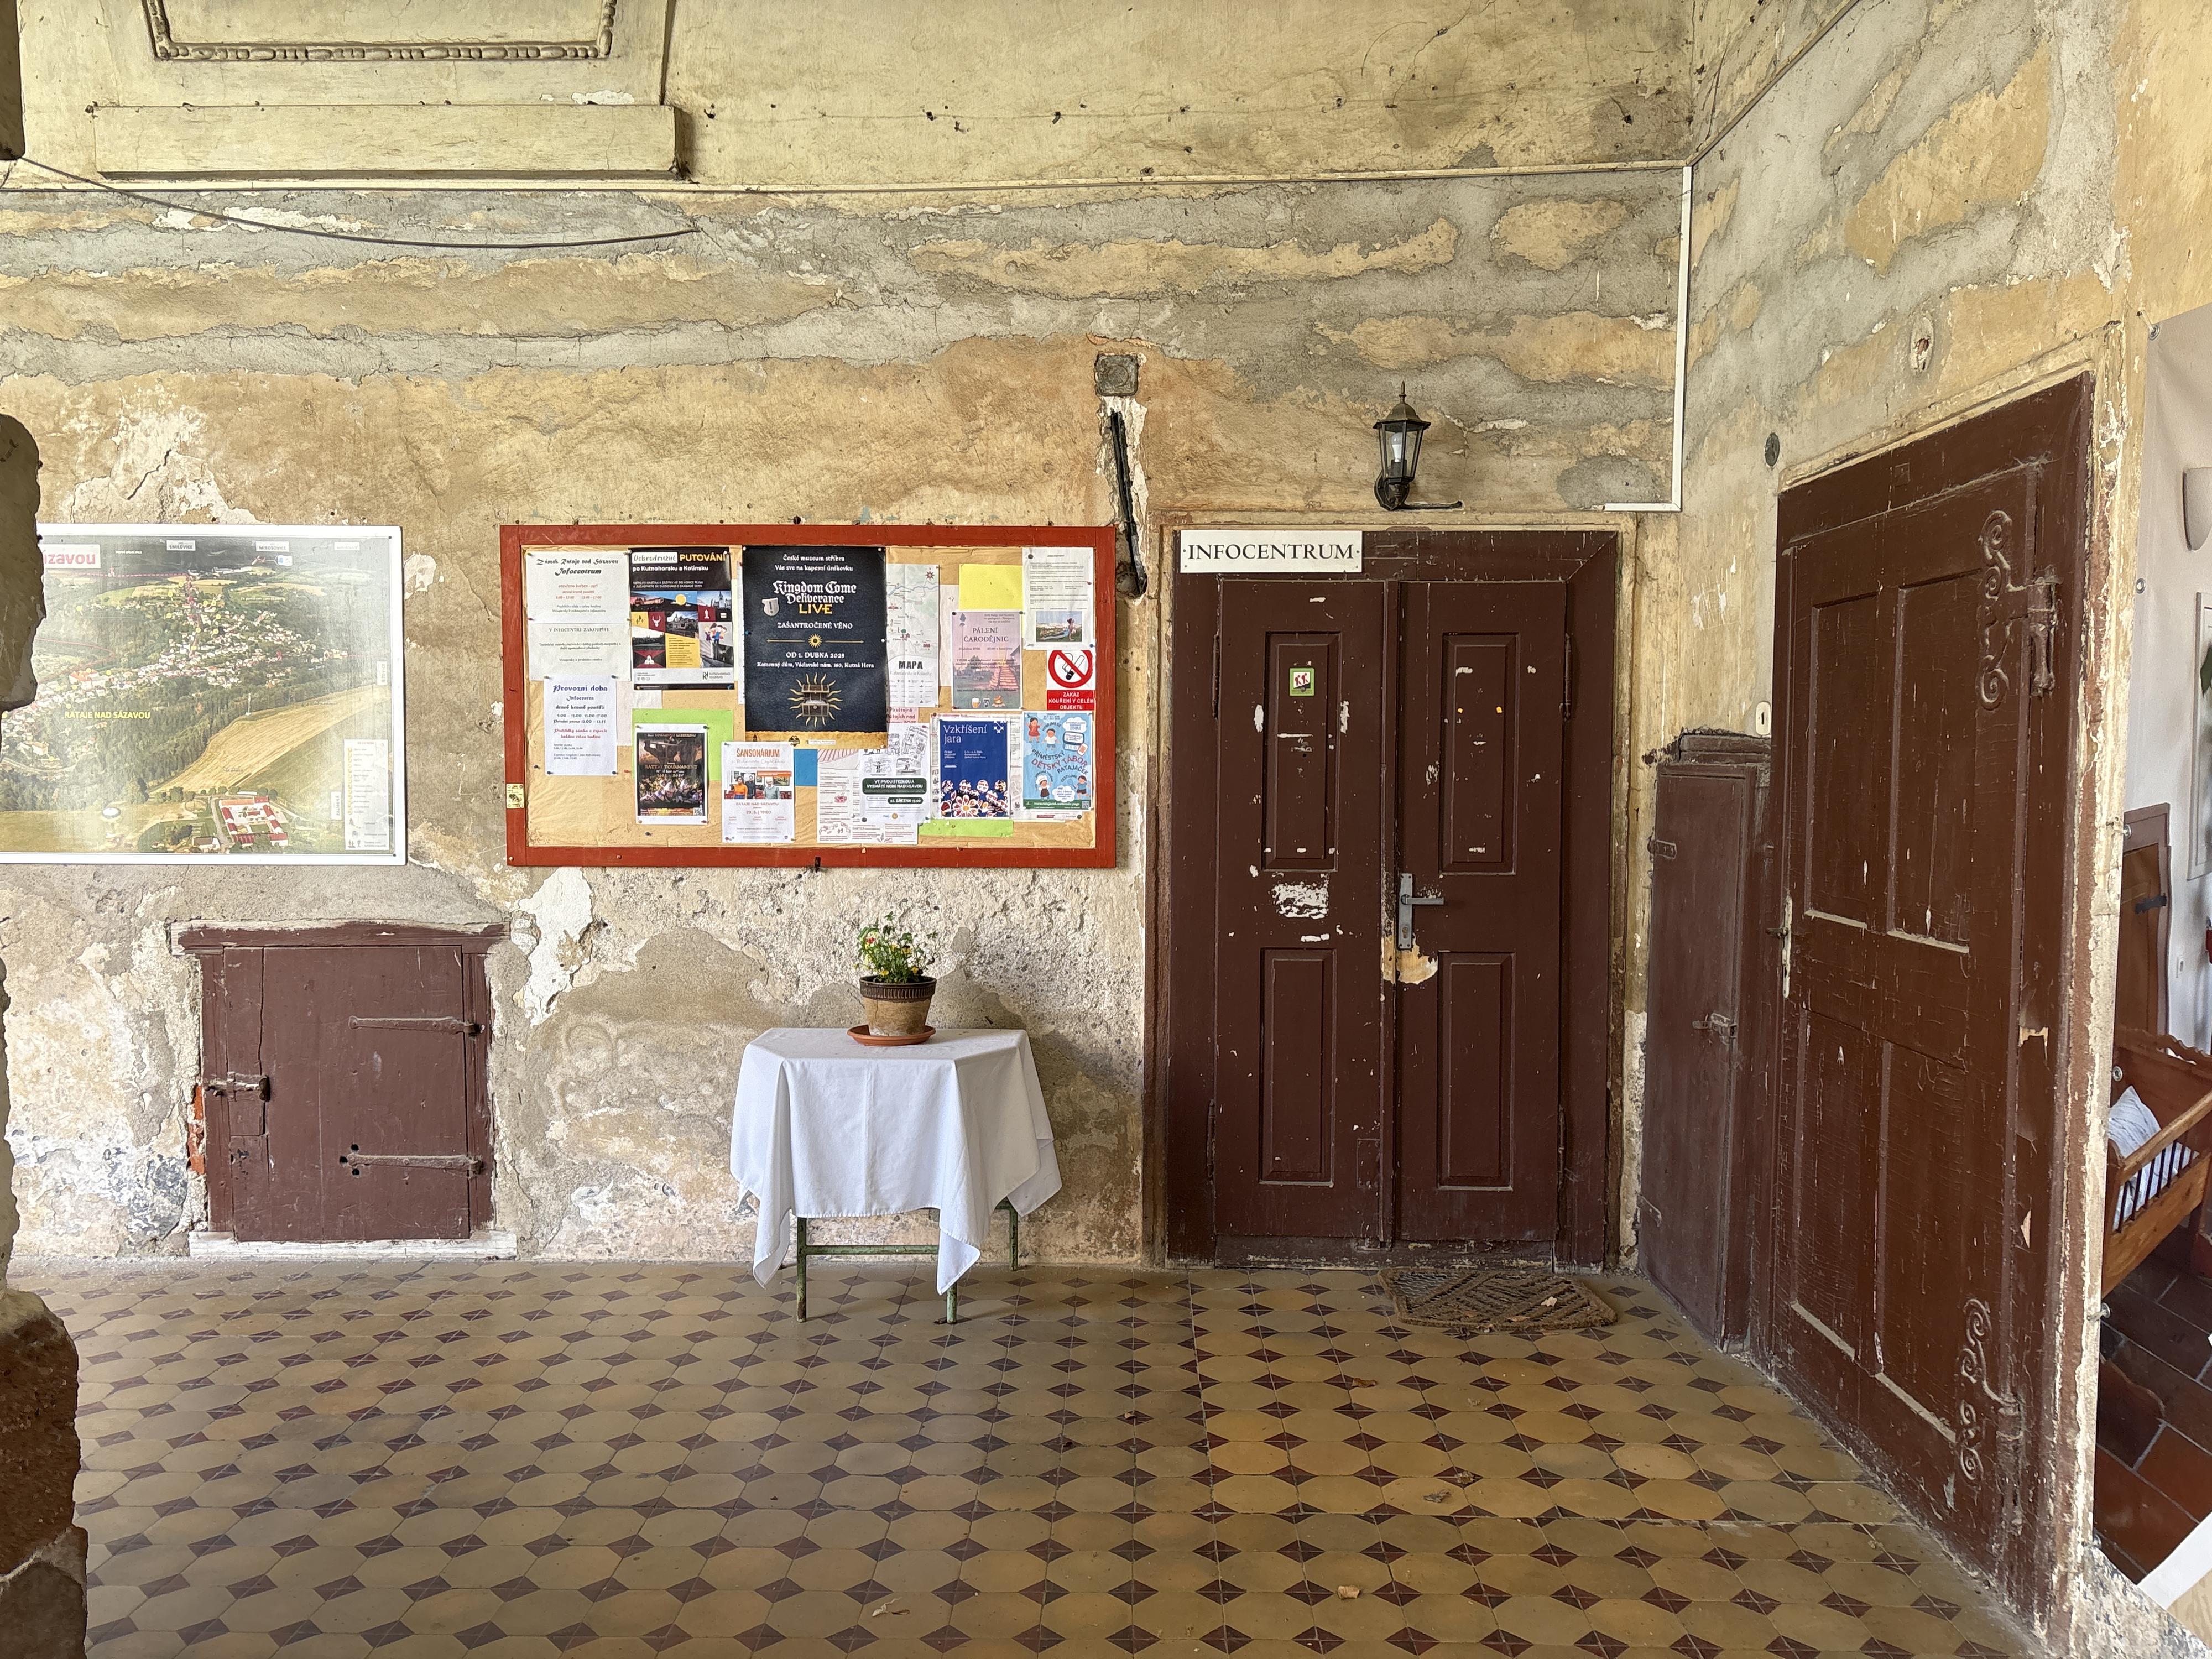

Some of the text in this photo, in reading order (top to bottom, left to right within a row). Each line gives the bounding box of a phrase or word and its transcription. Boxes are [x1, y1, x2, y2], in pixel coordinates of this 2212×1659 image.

[679, 552, 727, 562] PUTOVÁNÍ
[1187, 544, 1355, 560] INFOCENTRUM
[554, 567, 602, 576] Infocentrum
[804, 564, 826, 572] kapesní
[773, 580, 857, 595] Kingdom Come
[785, 593, 844, 604] Deliverance
[799, 603, 833, 614] LIVE
[777, 620, 853, 630] ZAŠANTROČENÉ VĚNO
[963, 635, 1009, 643] ČARODĚJNIC
[898, 660, 924, 670] MAPA
[64, 711, 92, 719] RATAJE
[113, 709, 151, 719] SÁZAVOU
[942, 724, 988, 734] Vzkříšení
[943, 734, 962, 745] jara
[736, 747, 780, 758] ŠANSONÁRIUM
[1031, 748, 1065, 760] PŘÍMĚSTSKÝ
[1031, 754, 1088, 770] DĚTSKÝ TÁBOR
[1056, 764, 1089, 776] RATAJÁČEK
